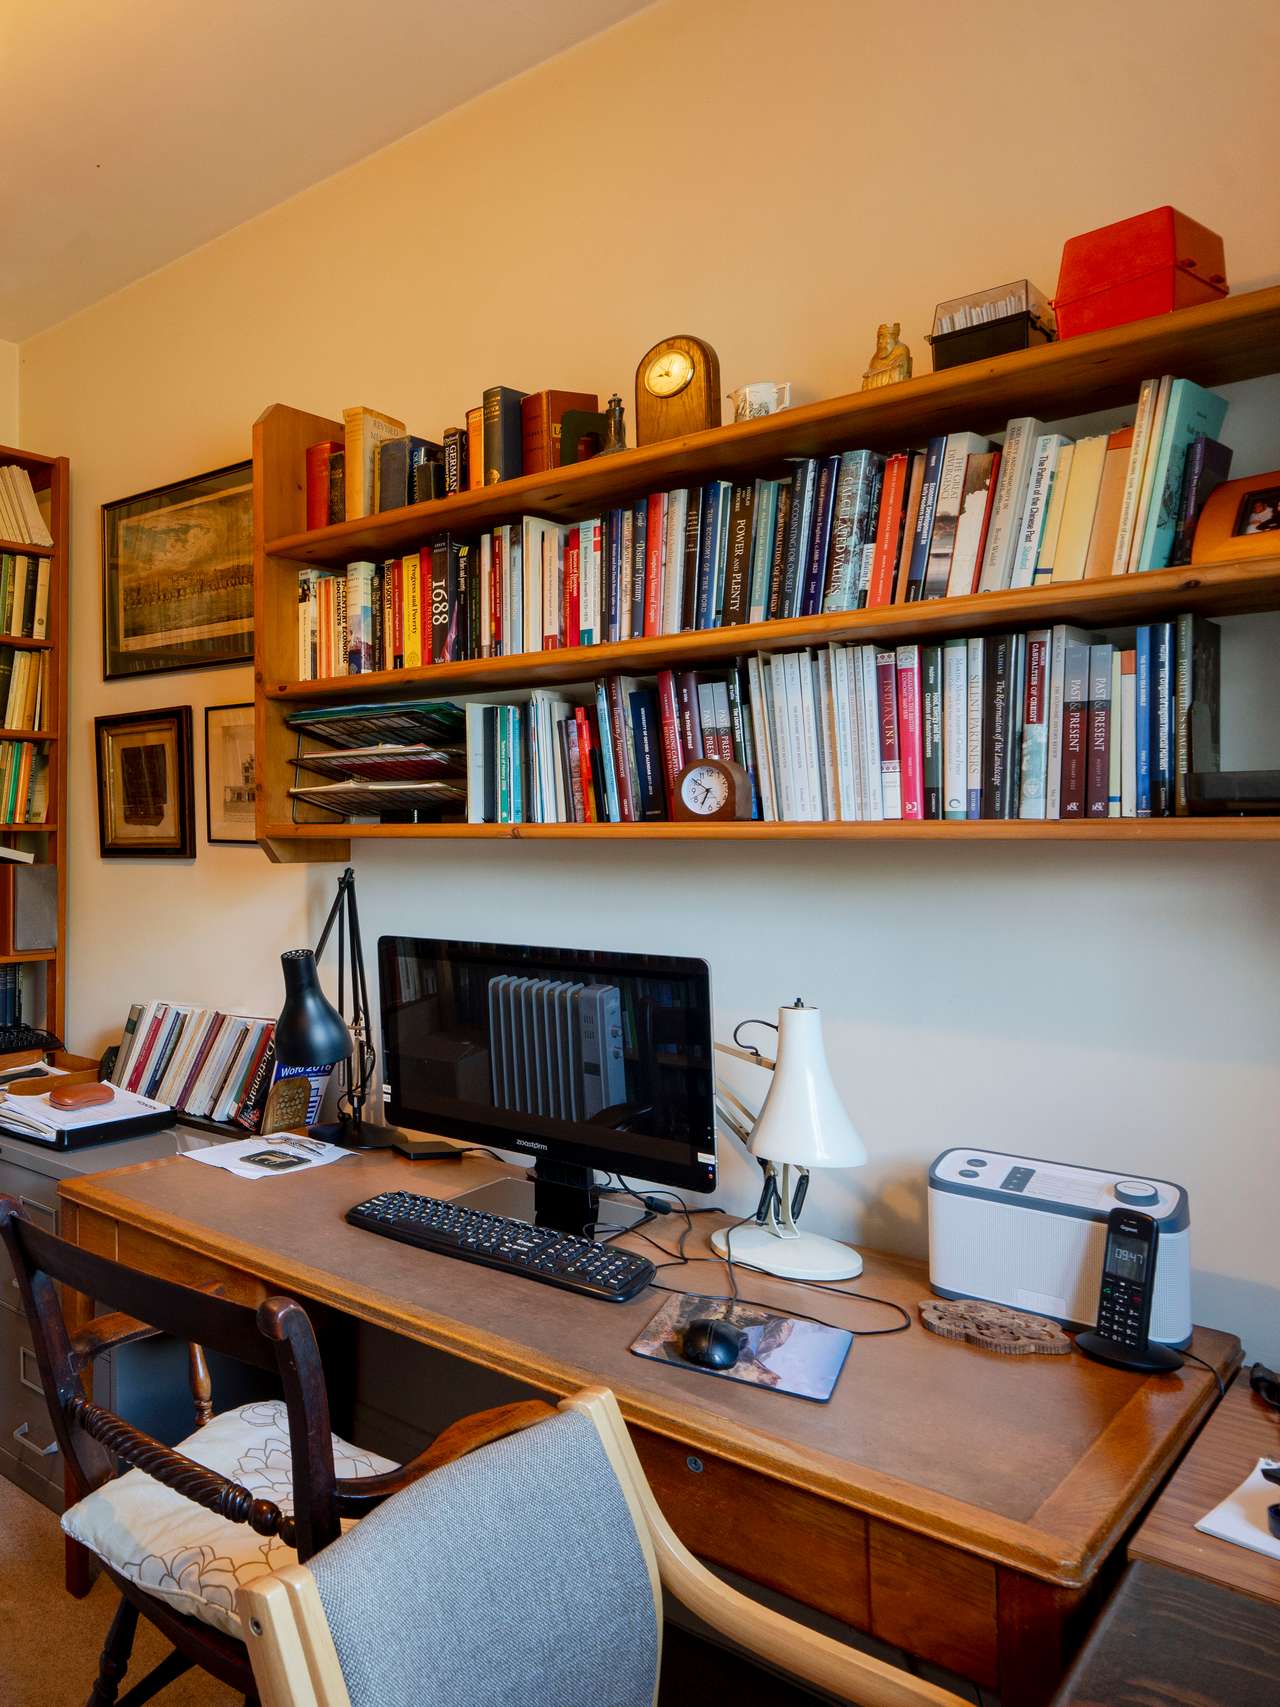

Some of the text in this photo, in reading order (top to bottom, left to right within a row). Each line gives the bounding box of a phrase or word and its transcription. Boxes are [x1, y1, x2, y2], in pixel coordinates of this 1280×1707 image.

[449, 445, 457, 491] GERMAN
[942, 449, 958, 500] DIVERGENCE
[950, 457, 964, 499] THE GREAT
[1034, 467, 1047, 488] Pattern
[1038, 456, 1050, 466] The
[916, 496, 928, 532] Modern France
[922, 482, 937, 538] Economic Development
[1028, 506, 1040, 529] Chinese
[1031, 496, 1042, 506] the
[784, 498, 800, 593] ACCOUNTING FOR ONESELF
[830, 477, 853, 596] CALCULATED VALUES
[1024, 530, 1036, 542] Past
[410, 564, 418, 592] Progress
[632, 543, 645, 602] Distant Tyranny
[700, 509, 714, 613] THE ECONOMY OF THE WORD
[730, 519, 746, 612] POWER AND PLENTY
[432, 579, 448, 625] 1688
[770, 593, 779, 612] MIND
[772, 577, 780, 592] THE
[410, 604, 418, 634] Poverty
[996, 680, 1005, 692] The
[1030, 644, 1040, 722] CASUALTIES OF CREDIT
[704, 710, 712, 726] PAST
[719, 710, 728, 726] PAST
[884, 680, 896, 745] INDIAN INK
[969, 674, 980, 774] SILENT PARTNERS
[995, 694, 1005, 734] Reformation
[1069, 680, 1082, 752] PAST & PRESENT
[1094, 678, 1106, 751] PAST & PRESENT
[1158, 668, 1168, 770] The Origins Markets
[1179, 659, 1188, 774] PROMETHEUS SHACKLED
[615, 740, 626, 778] Improvement
[992, 752, 1003, 786] Landscape
[995, 744, 1004, 752] the
[245, 1040, 276, 1107] Dictionary
